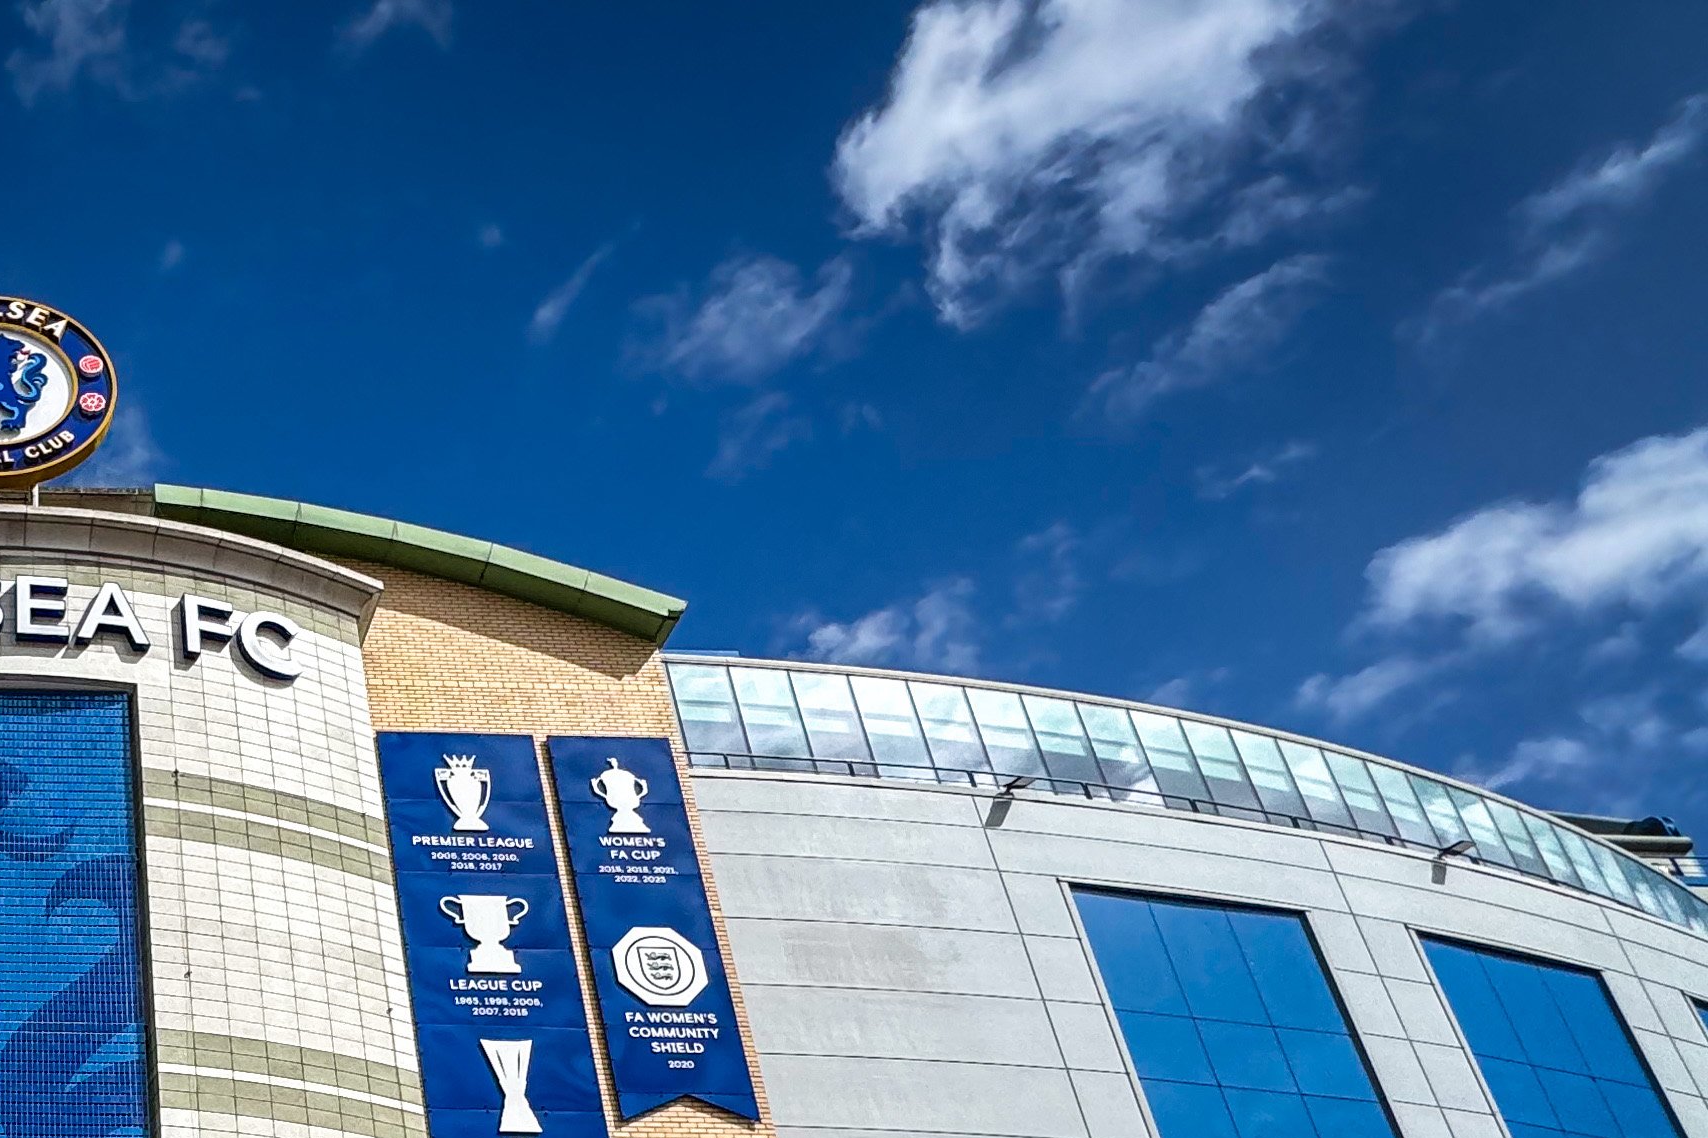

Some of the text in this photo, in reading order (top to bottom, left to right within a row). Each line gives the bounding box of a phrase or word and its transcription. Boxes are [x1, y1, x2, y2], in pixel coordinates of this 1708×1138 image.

[25, 430, 75, 459] CLUB
[179, 593, 304, 679] FC
[412, 836, 534, 849] PREMIER LEAGUE
[599, 836, 666, 848] WOMEN'S
[611, 850, 661, 860] FA CUP
[450, 979, 543, 992] LEAGUE CUP
[625, 1012, 718, 1024] FA WOMEN'S
[629, 1026, 719, 1039] COMMUNITY
[651, 1042, 705, 1054] SHIELD
[668, 1060, 695, 1069] 2020
